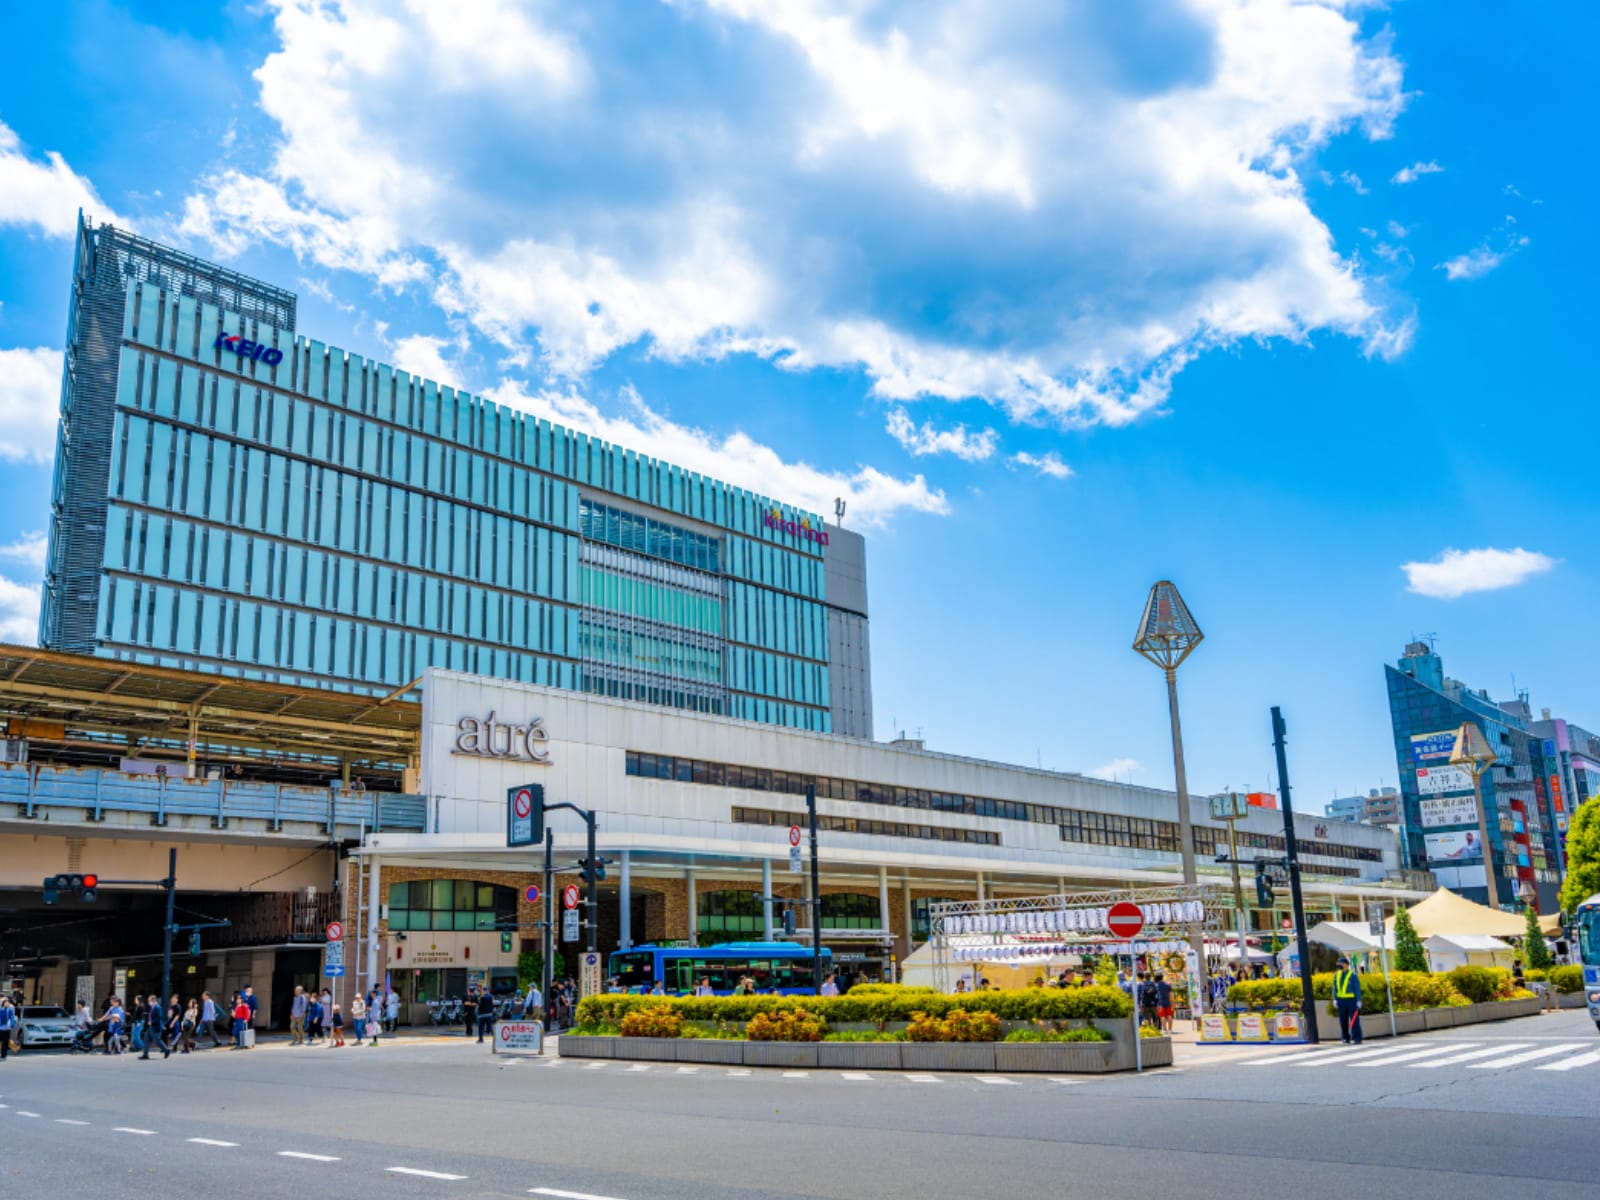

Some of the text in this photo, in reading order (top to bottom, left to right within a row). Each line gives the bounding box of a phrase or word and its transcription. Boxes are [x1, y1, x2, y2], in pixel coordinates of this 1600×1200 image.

[214, 332, 283, 366] KEIO
[764, 507, 829, 546] kirarina
[456, 710, 550, 761] atré
